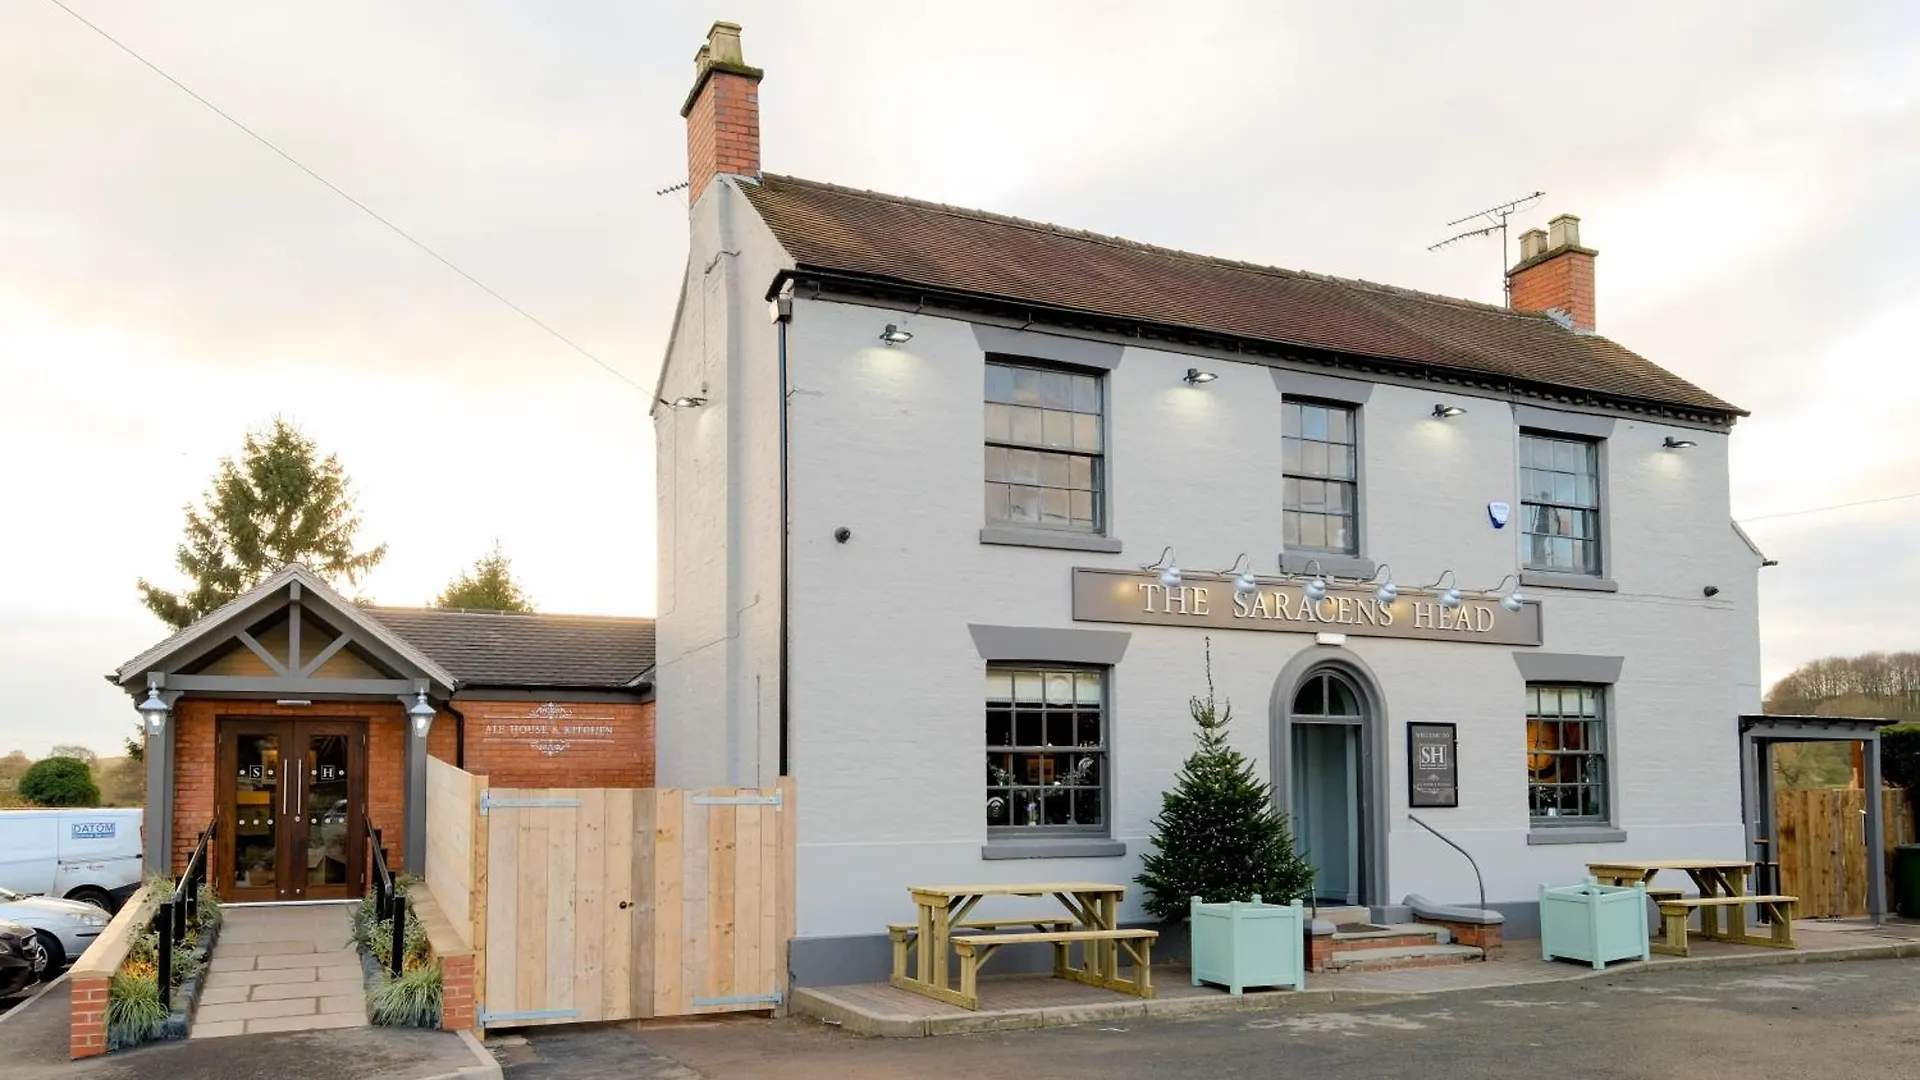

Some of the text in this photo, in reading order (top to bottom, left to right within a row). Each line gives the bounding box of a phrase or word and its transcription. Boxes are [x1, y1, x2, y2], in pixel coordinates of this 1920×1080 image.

[1139, 583, 1210, 616] THE
[1413, 601, 1495, 632] HEAD
[484, 724, 505, 735] ALE
[510, 724, 549, 735] HOUSE
[1421, 746, 1444, 764] SH
[252, 767, 260, 777] S
[322, 767, 333, 778] H
[73, 824, 114, 833] DATOM
